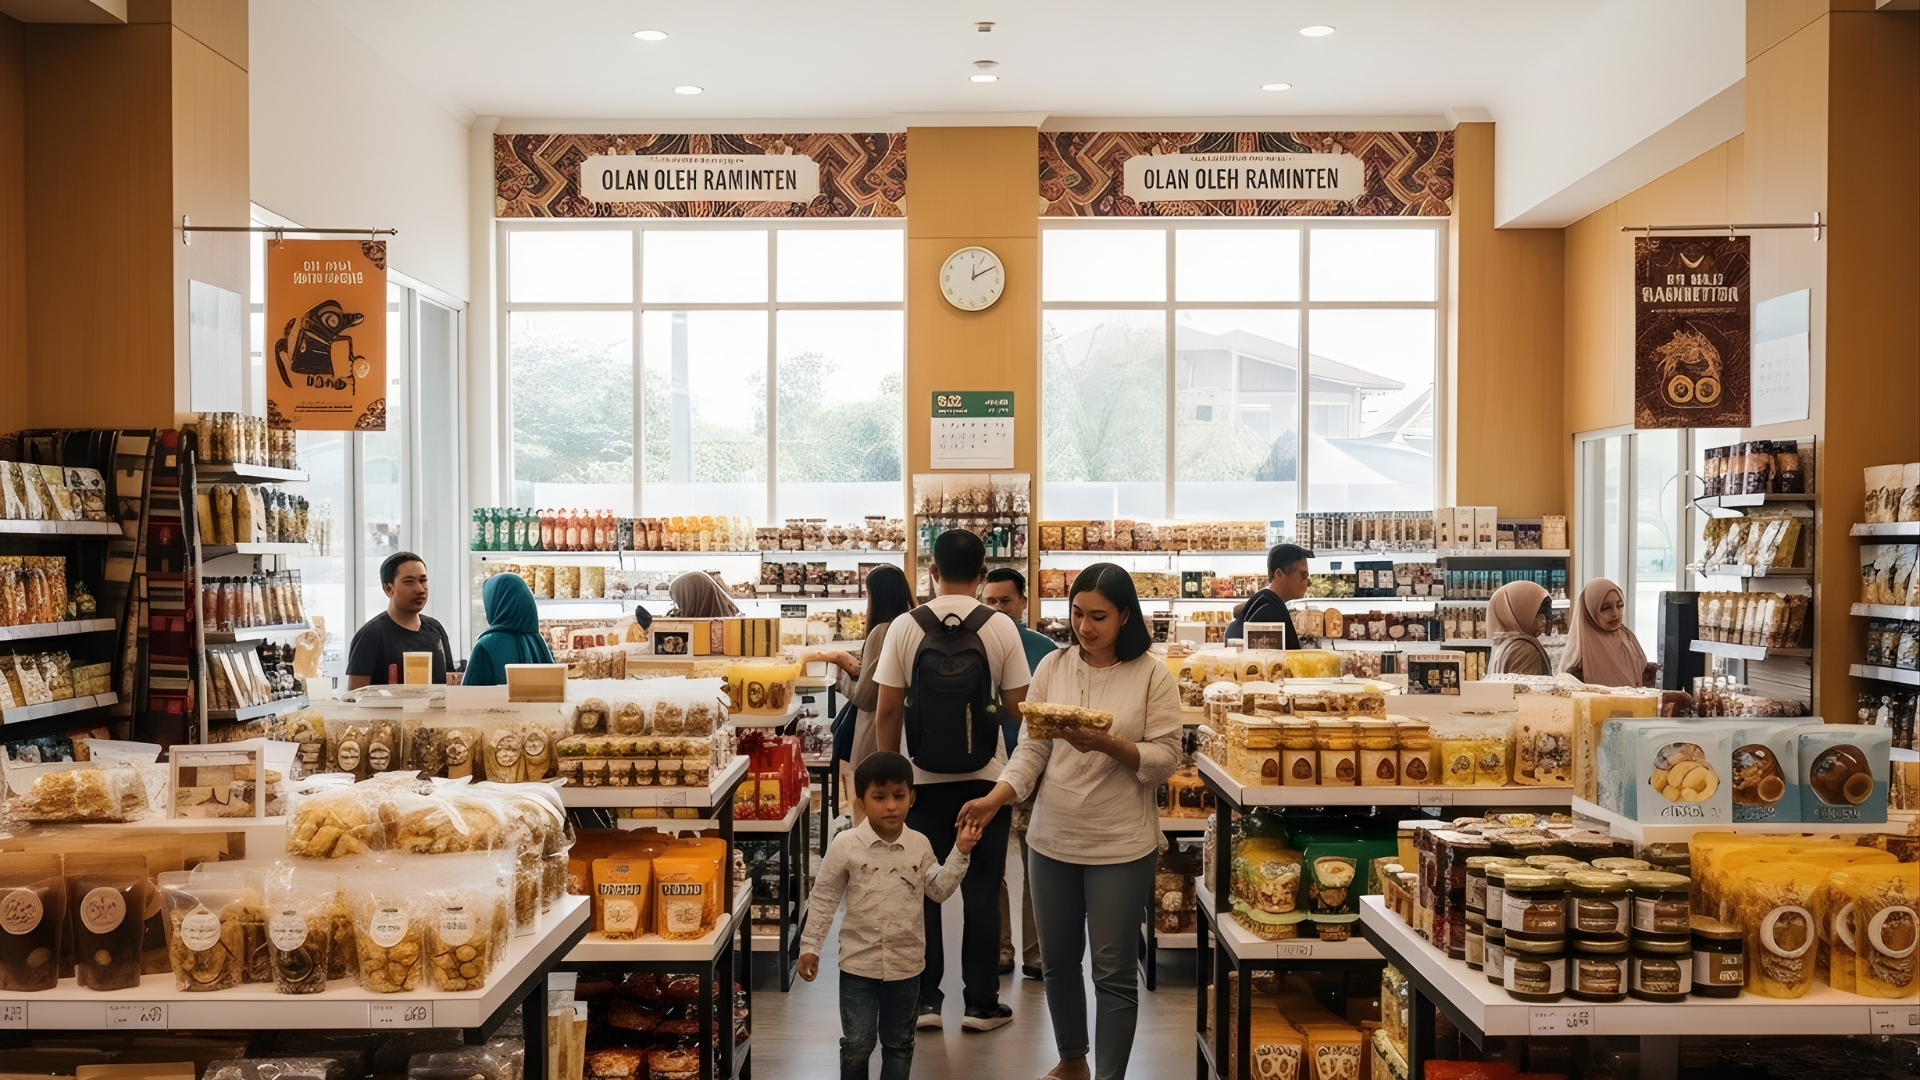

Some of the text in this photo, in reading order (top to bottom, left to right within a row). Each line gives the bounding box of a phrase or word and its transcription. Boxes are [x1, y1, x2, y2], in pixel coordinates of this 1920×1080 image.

[602, 169, 797, 191] OLAN OLEH RAMINTEN
[1144, 167, 1339, 190] OLAN OLEH RAMINTEN
